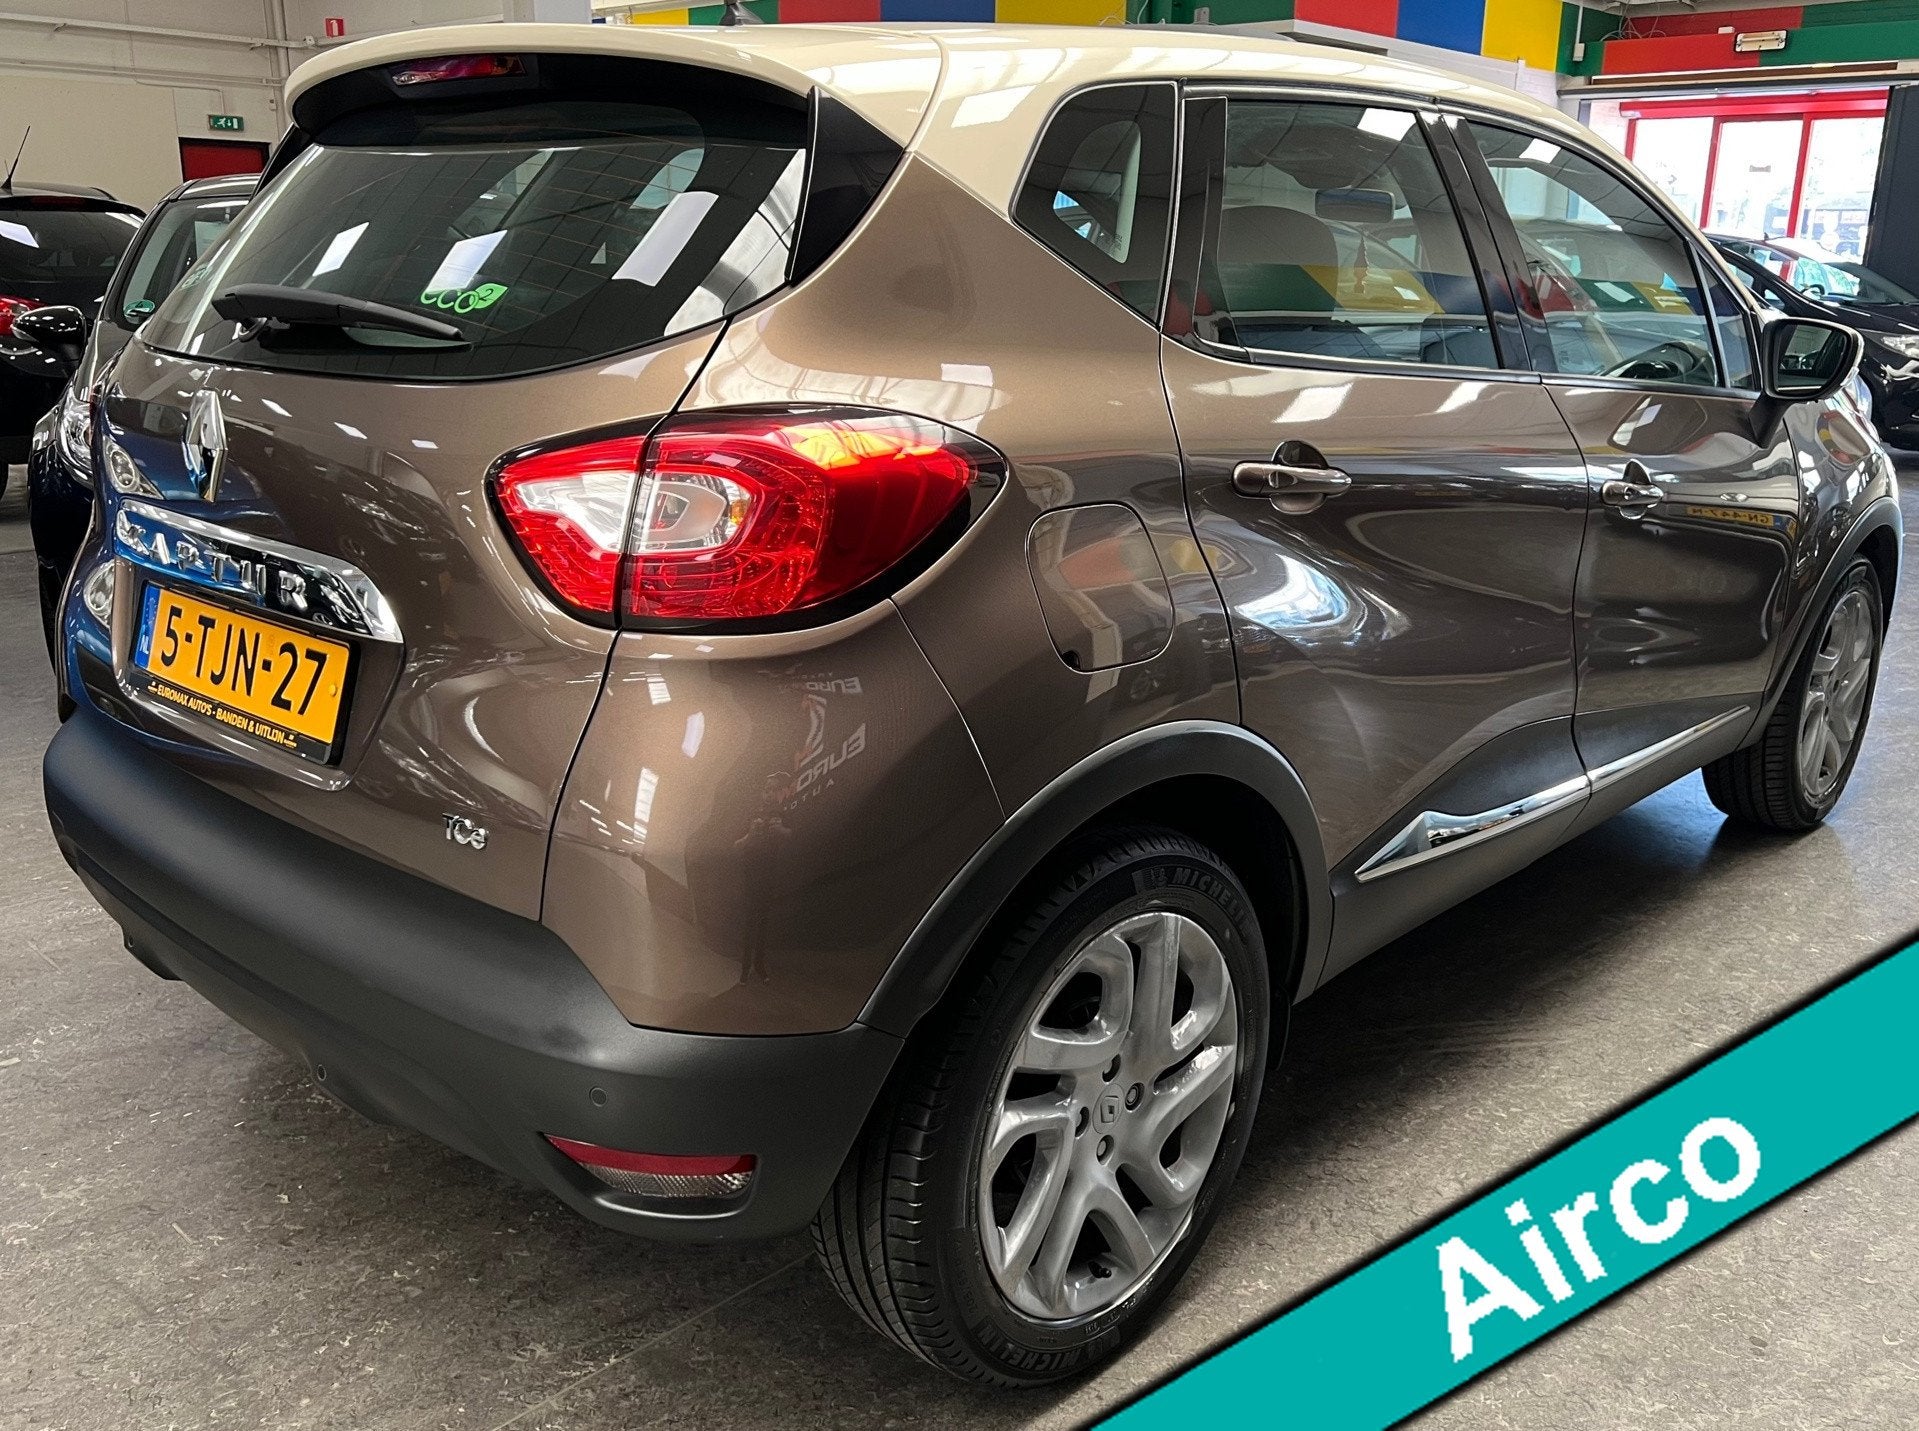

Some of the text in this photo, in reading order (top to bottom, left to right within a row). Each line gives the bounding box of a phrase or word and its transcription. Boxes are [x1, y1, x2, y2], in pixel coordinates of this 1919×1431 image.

[160, 604, 328, 717] 5-TJN-27
[157, 684, 189, 706] EUROMAX
[187, 696, 212, 716] AUTO'S
[216, 707, 247, 730] BANDEN
[248, 720, 255, 733] &
